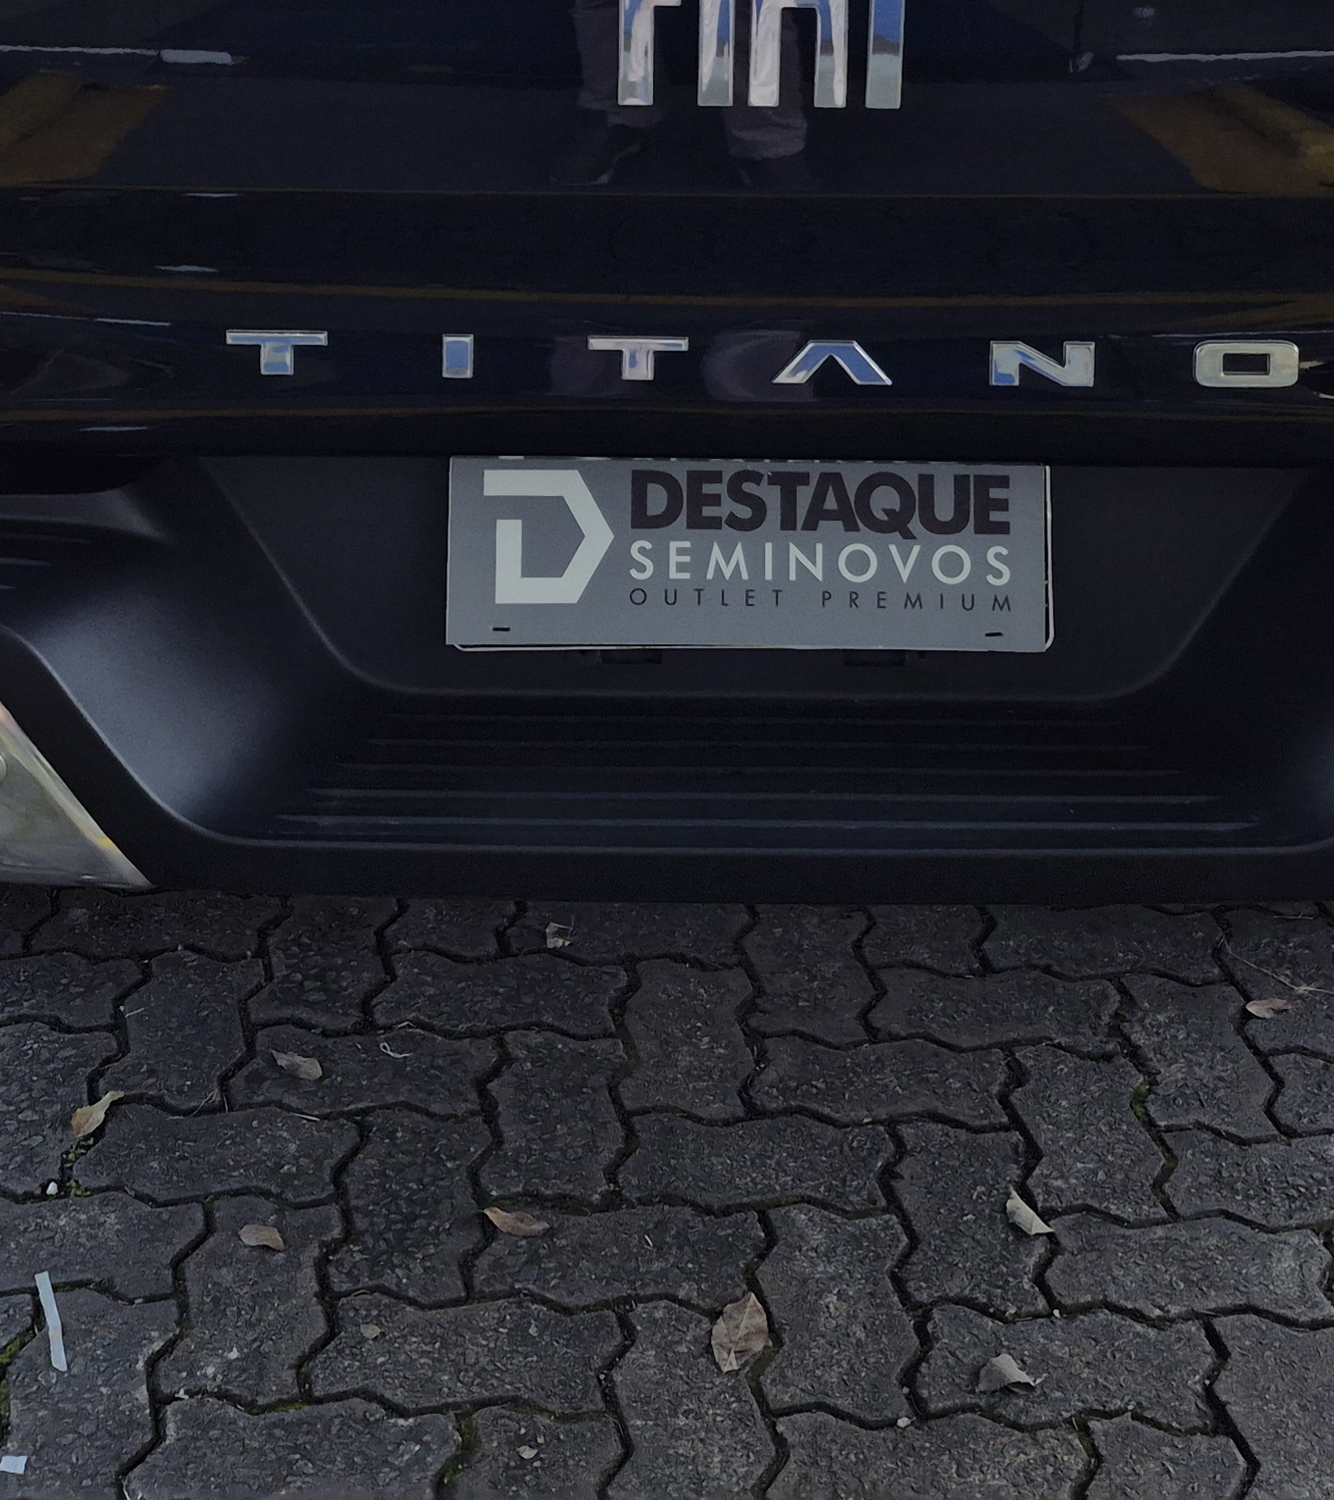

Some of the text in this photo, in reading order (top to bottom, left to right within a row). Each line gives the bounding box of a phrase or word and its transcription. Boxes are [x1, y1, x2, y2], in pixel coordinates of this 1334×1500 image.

[225, 330, 1301, 388] TITANO
[630, 469, 1012, 541] DESTAQUE
[629, 540, 1012, 586] SEMINOVOS
[629, 587, 1012, 612] OUTLET PREMIUM
